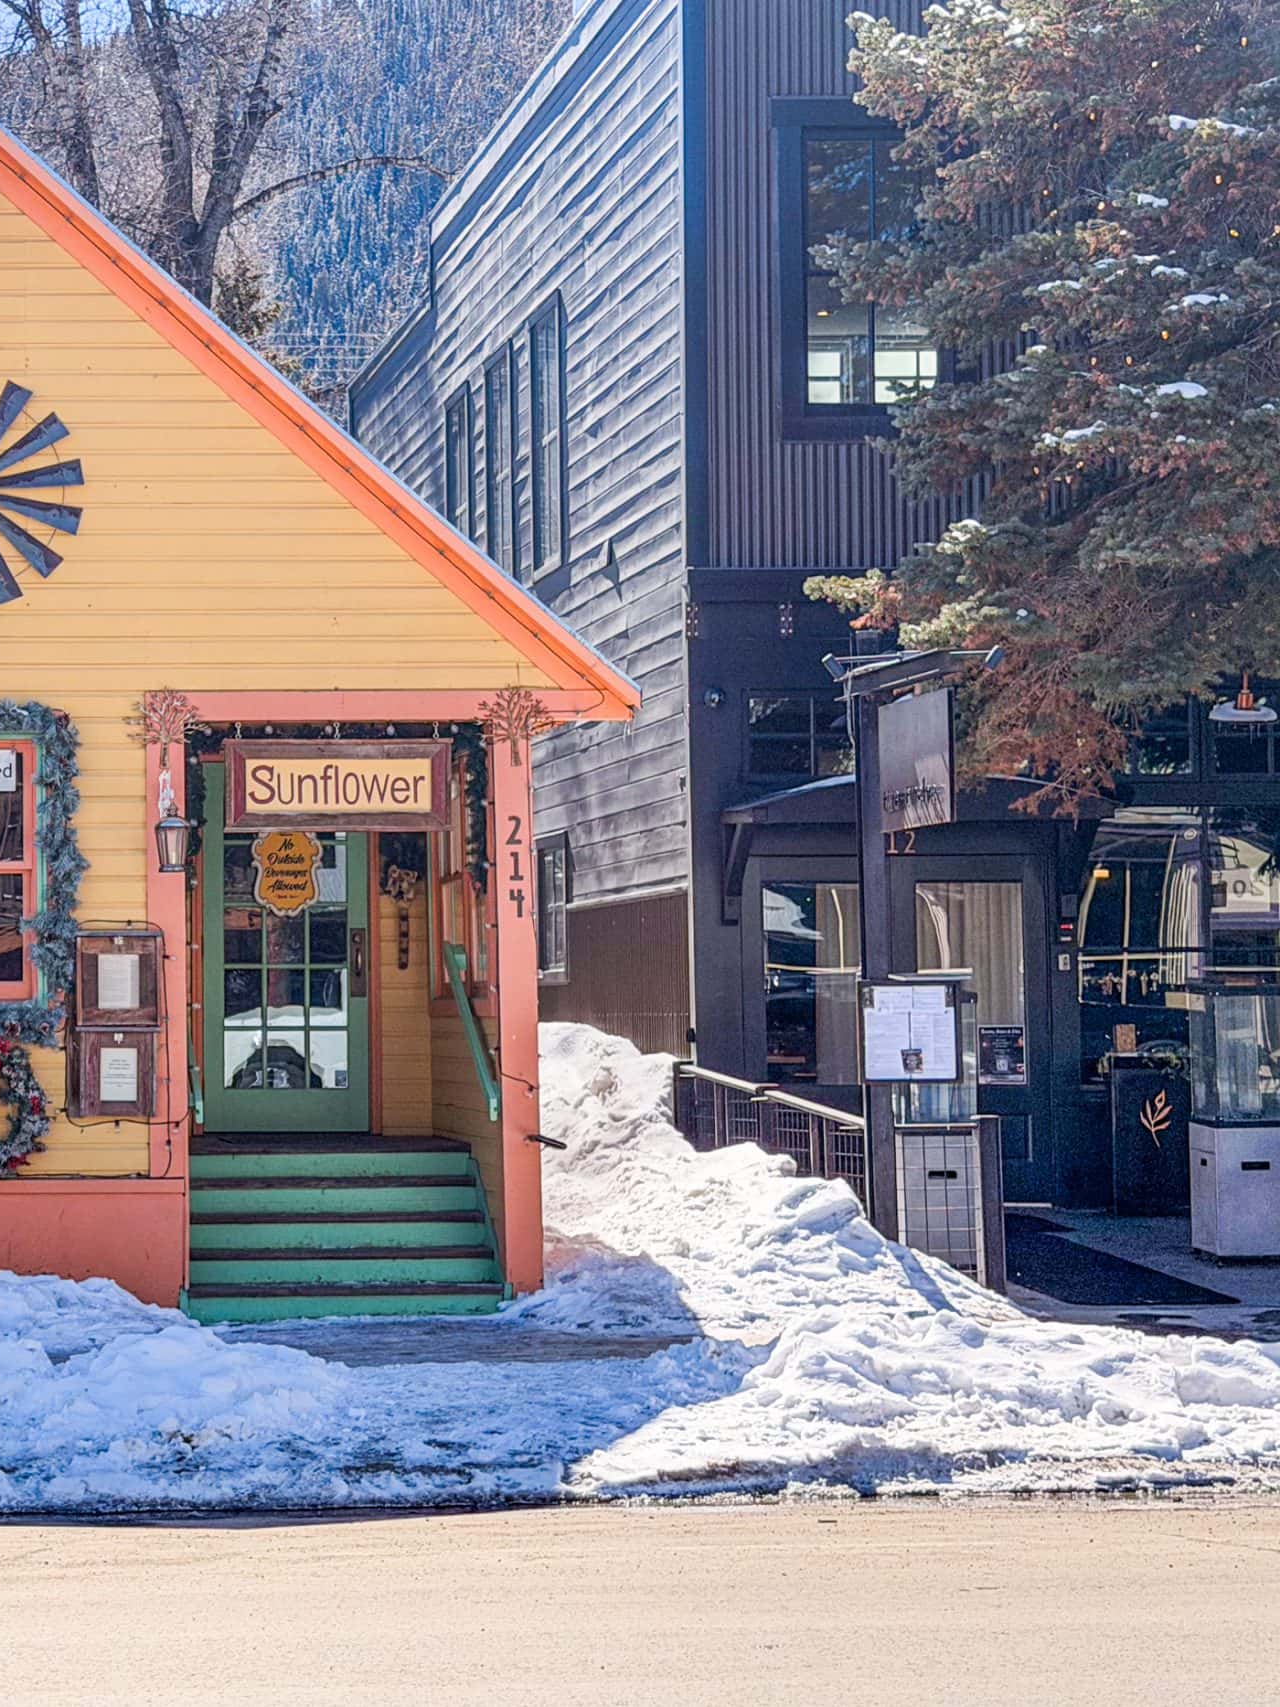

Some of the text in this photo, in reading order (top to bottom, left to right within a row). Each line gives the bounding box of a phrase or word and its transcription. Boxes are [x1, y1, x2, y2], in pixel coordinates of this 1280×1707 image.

[248, 764, 426, 805] Sunflower
[277, 838, 296, 853] No
[267, 852, 306, 866] Outside
[266, 880, 308, 894] Allowed
